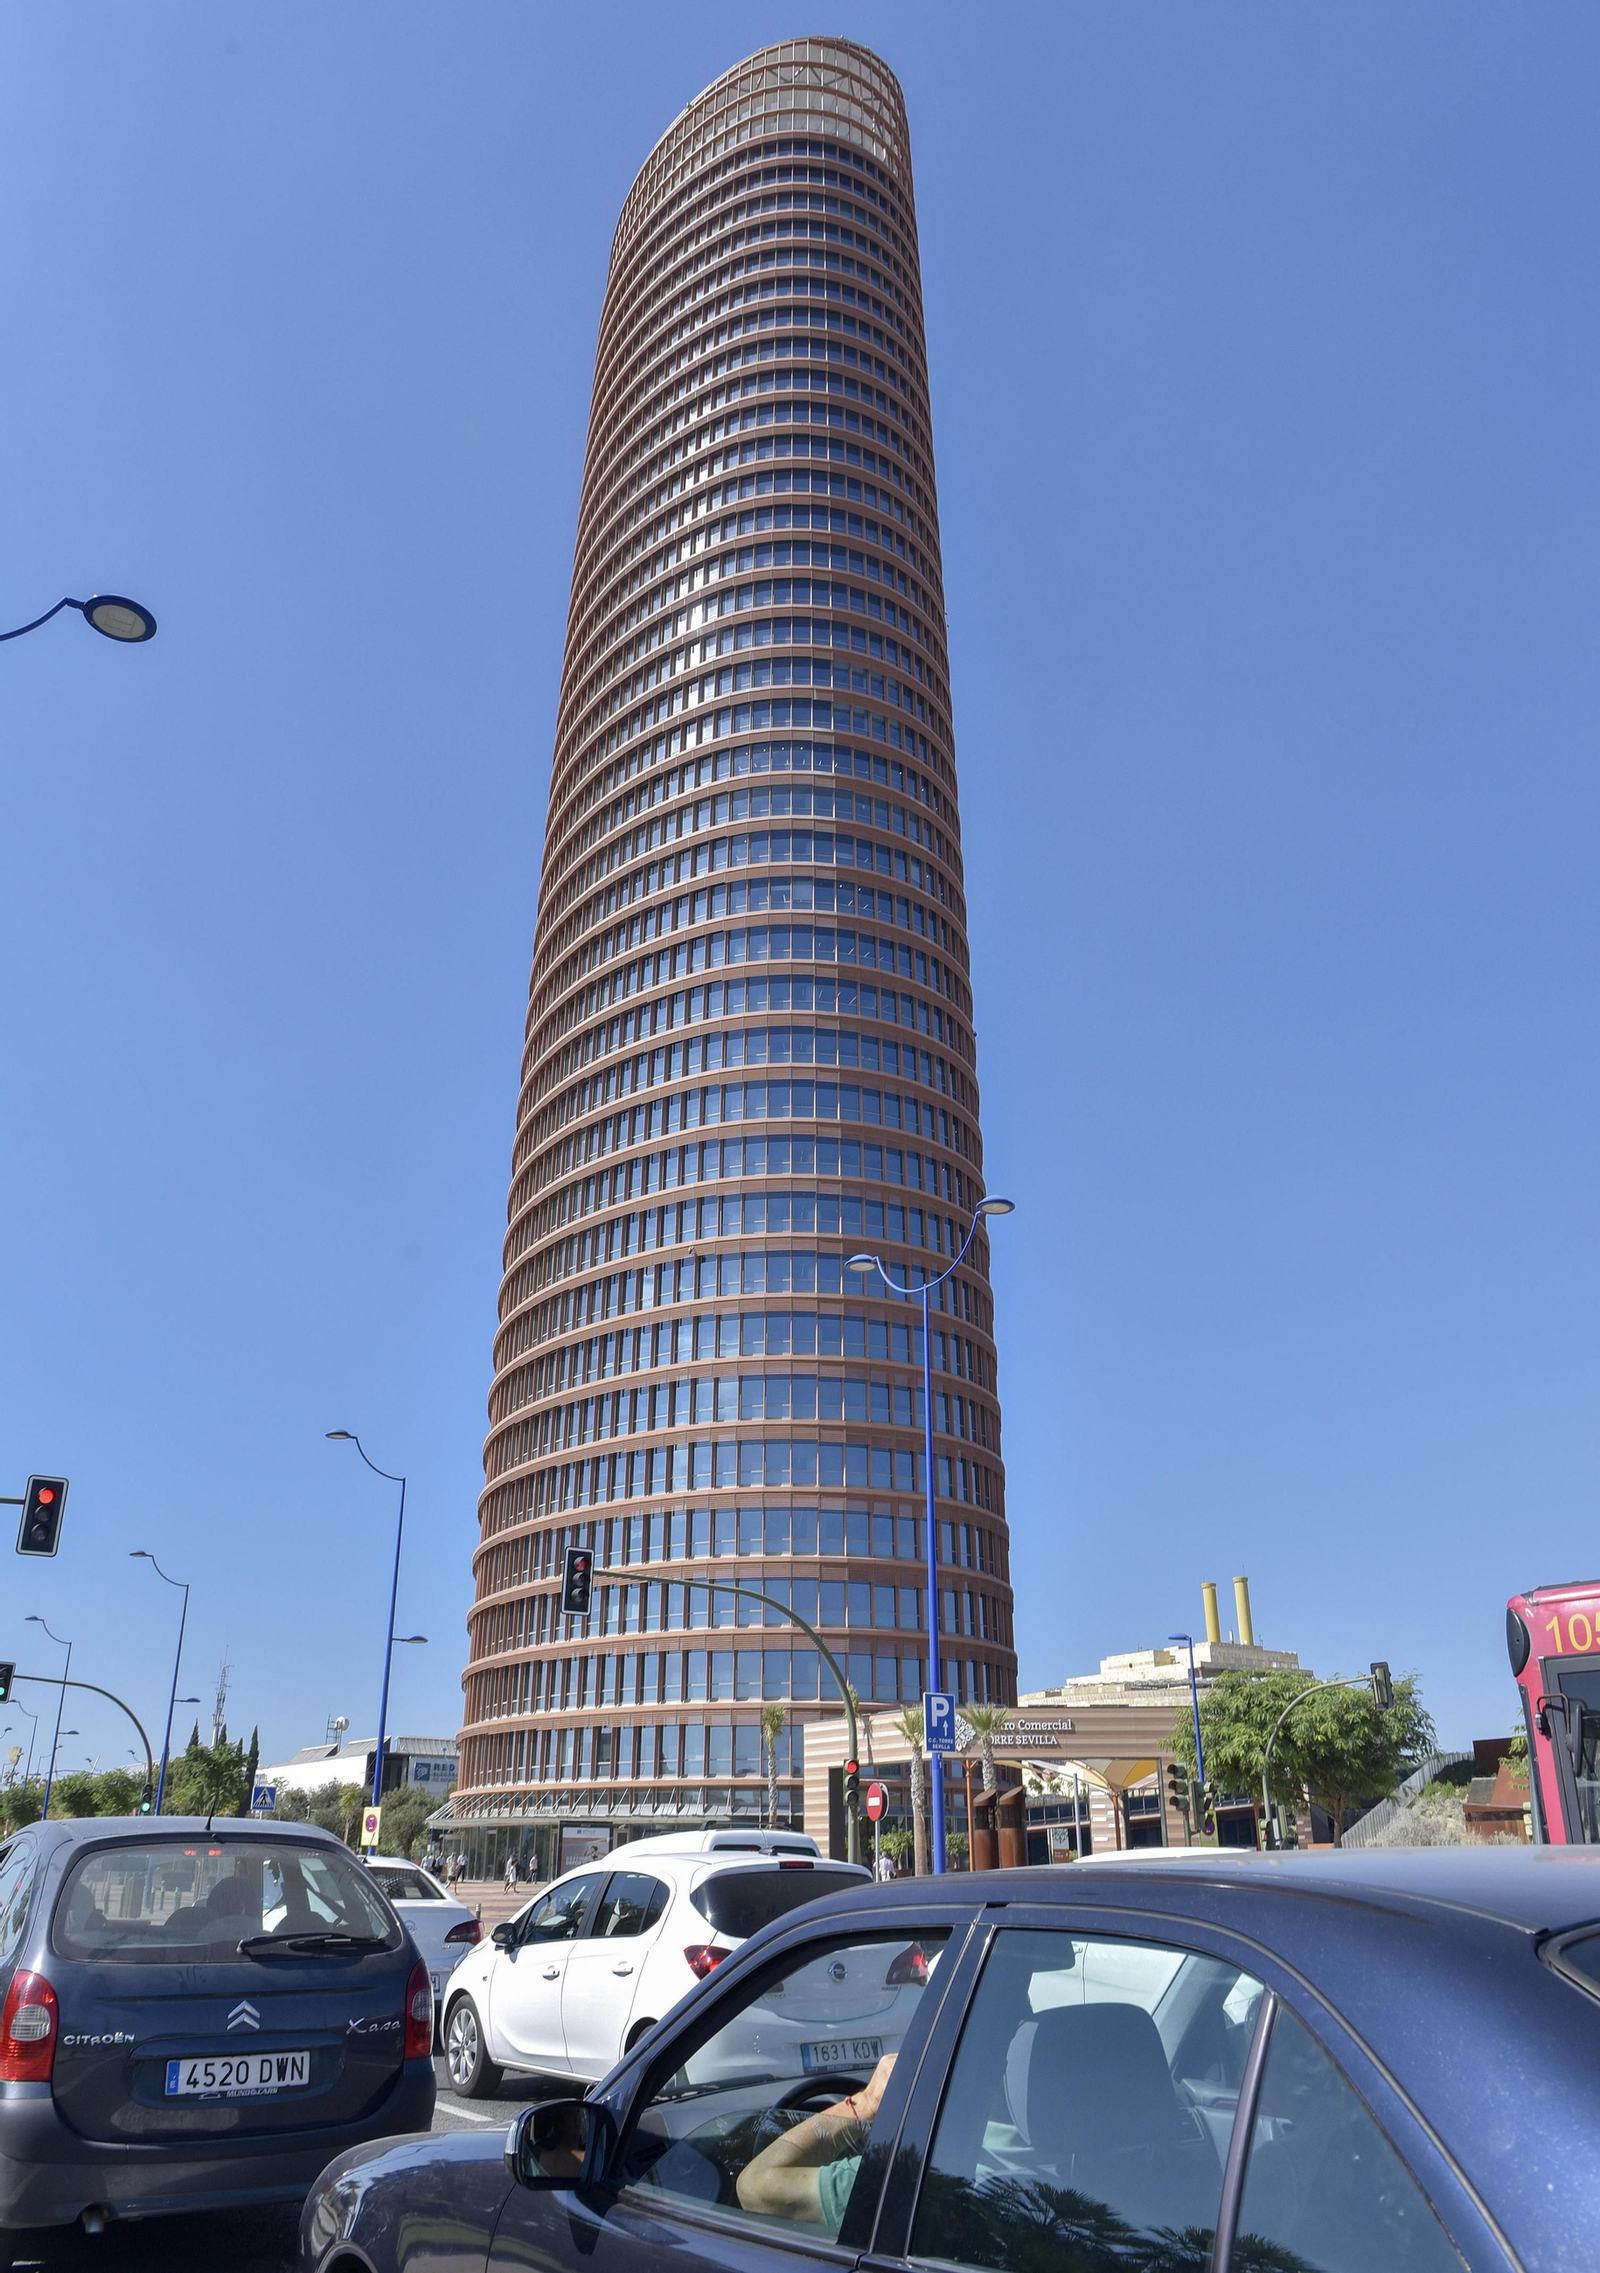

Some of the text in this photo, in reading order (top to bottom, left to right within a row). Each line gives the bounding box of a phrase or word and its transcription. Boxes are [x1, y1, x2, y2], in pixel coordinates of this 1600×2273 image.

[1546, 1612, 1600, 1653] 10
[931, 1696, 950, 1727] P
[1018, 1719, 1072, 1731] Comercial
[988, 1735, 1058, 1745] RRE SEVILLA
[433, 1763, 455, 1771] RED
[63, 2031, 135, 2046] CITROËN
[813, 2040, 880, 2063] 1631 KDW
[186, 2060, 250, 2089] 4520
[259, 2056, 304, 2084] DWN
